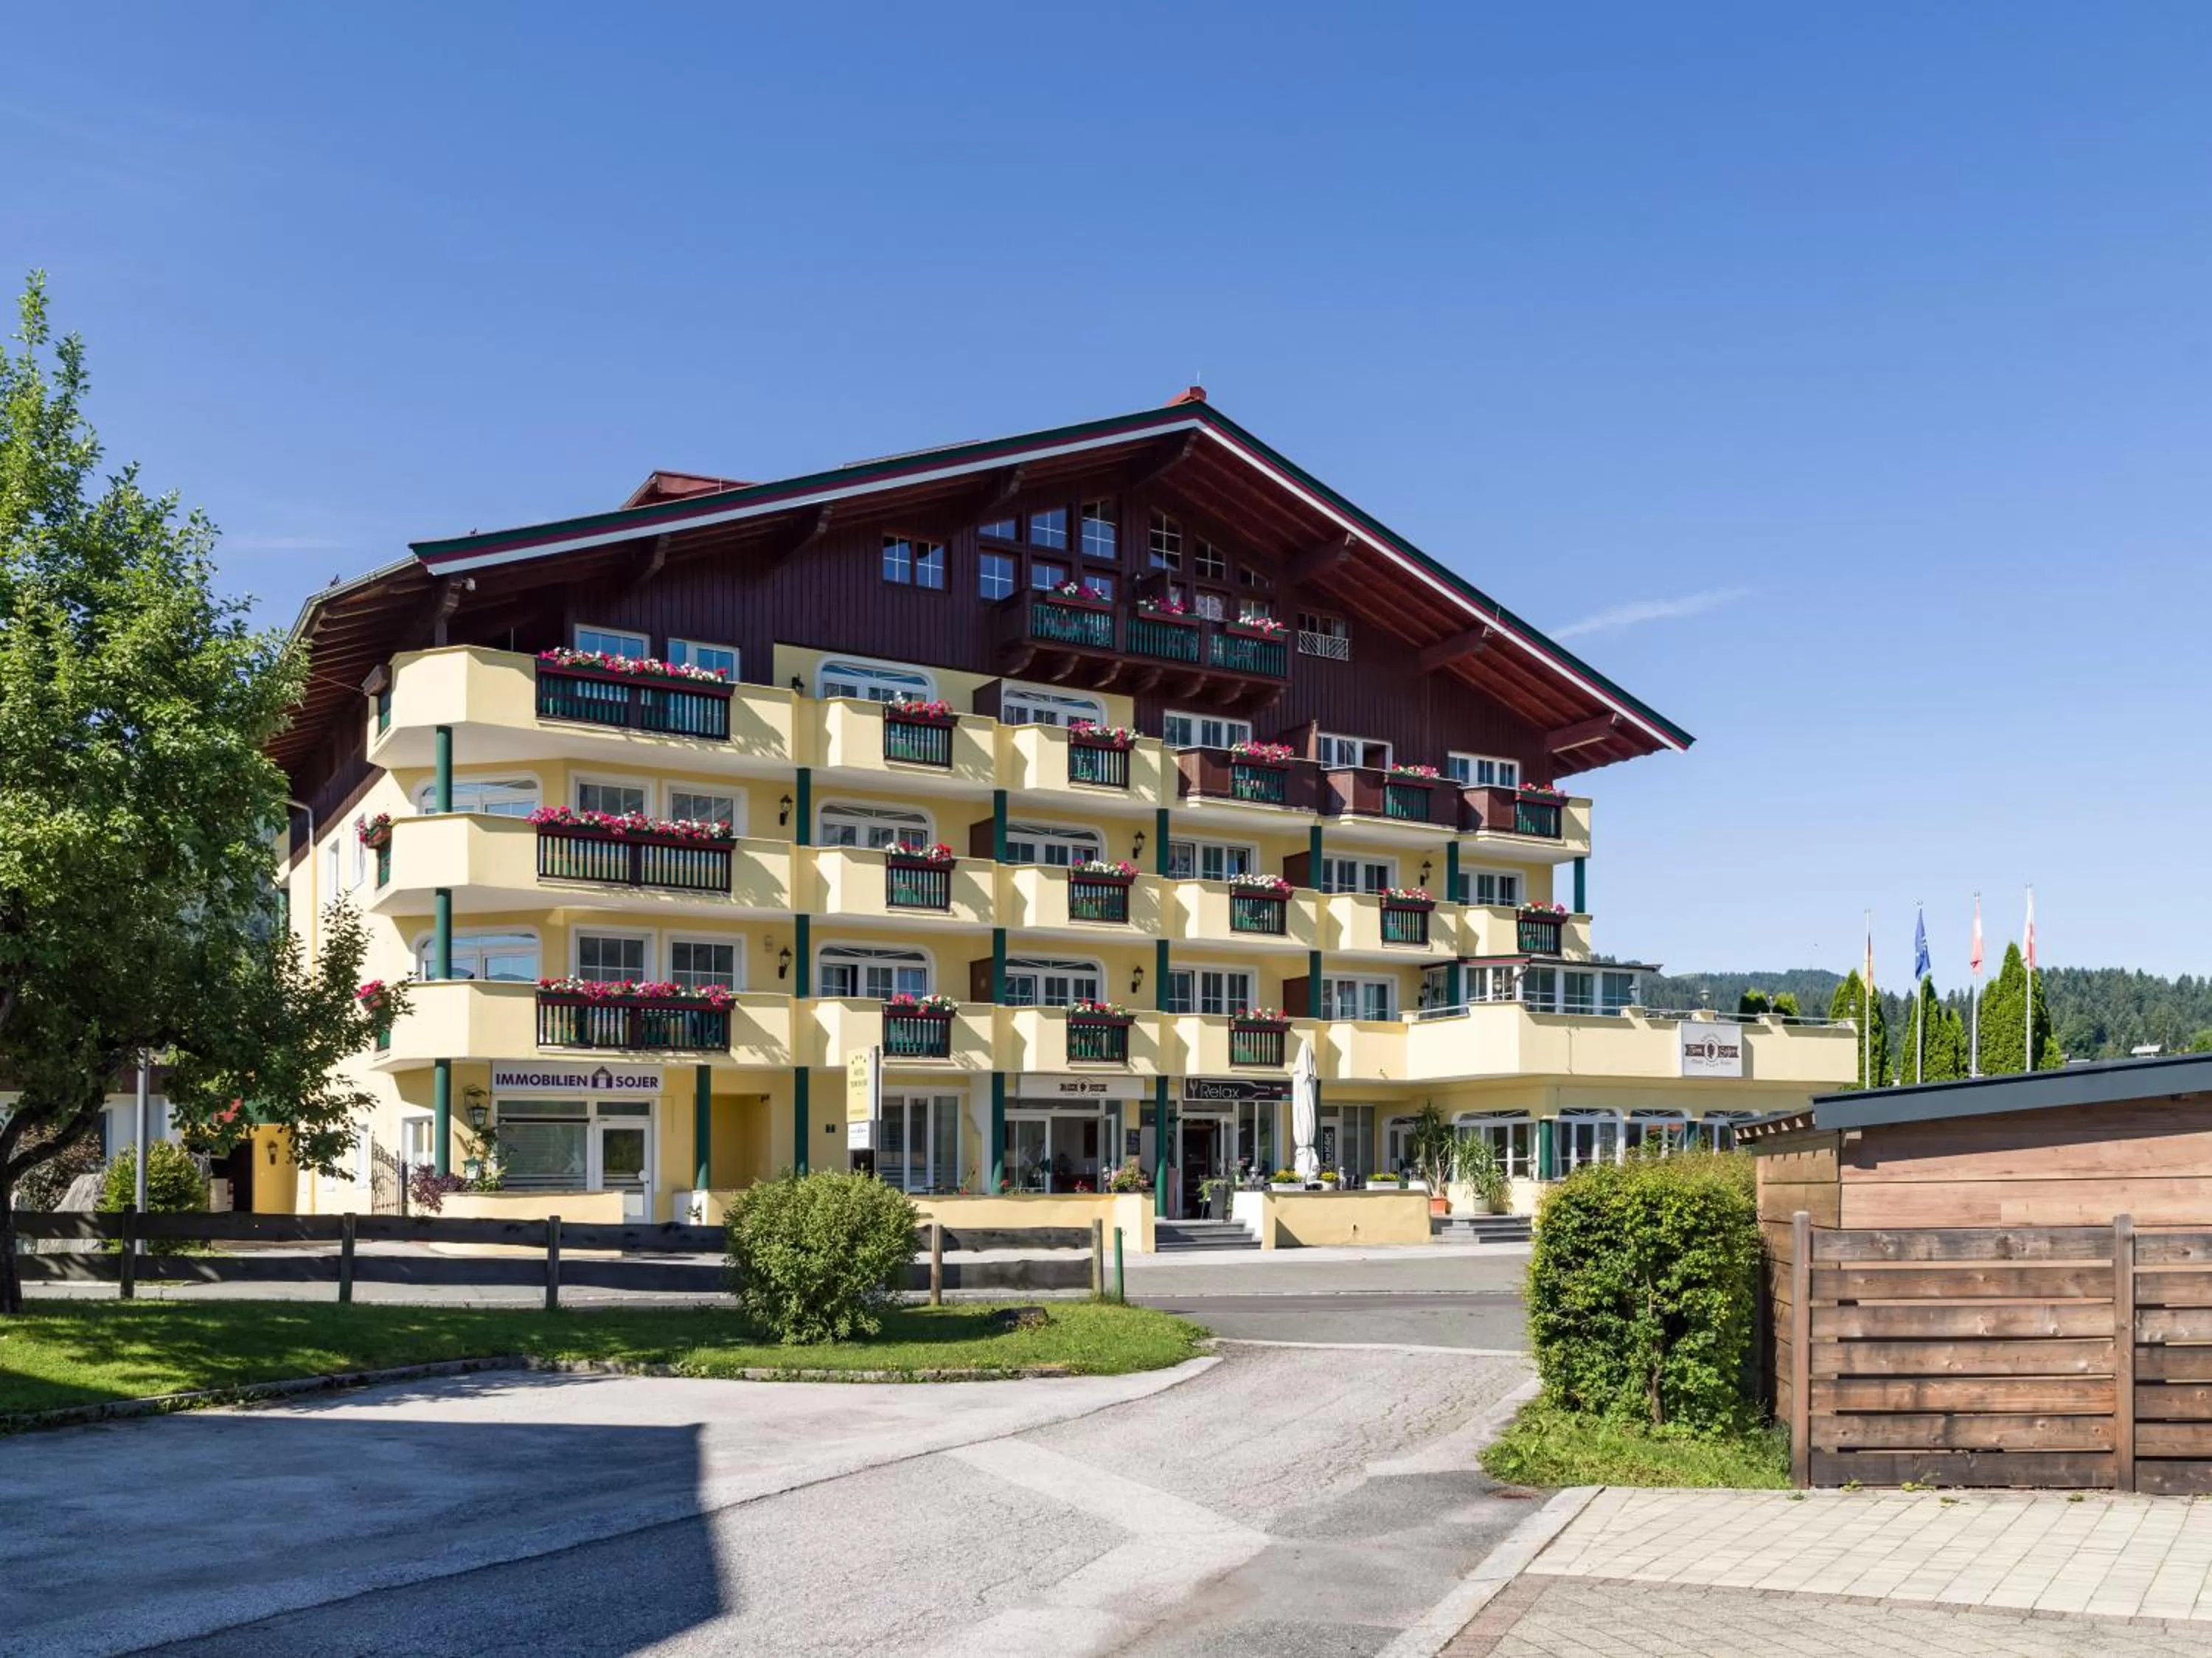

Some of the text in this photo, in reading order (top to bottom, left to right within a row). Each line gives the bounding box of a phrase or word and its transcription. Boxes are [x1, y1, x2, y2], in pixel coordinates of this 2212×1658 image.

[495, 1073, 658, 1088] IMMOBILIEN SOJER
[1200, 1083, 1239, 1098] Relax
